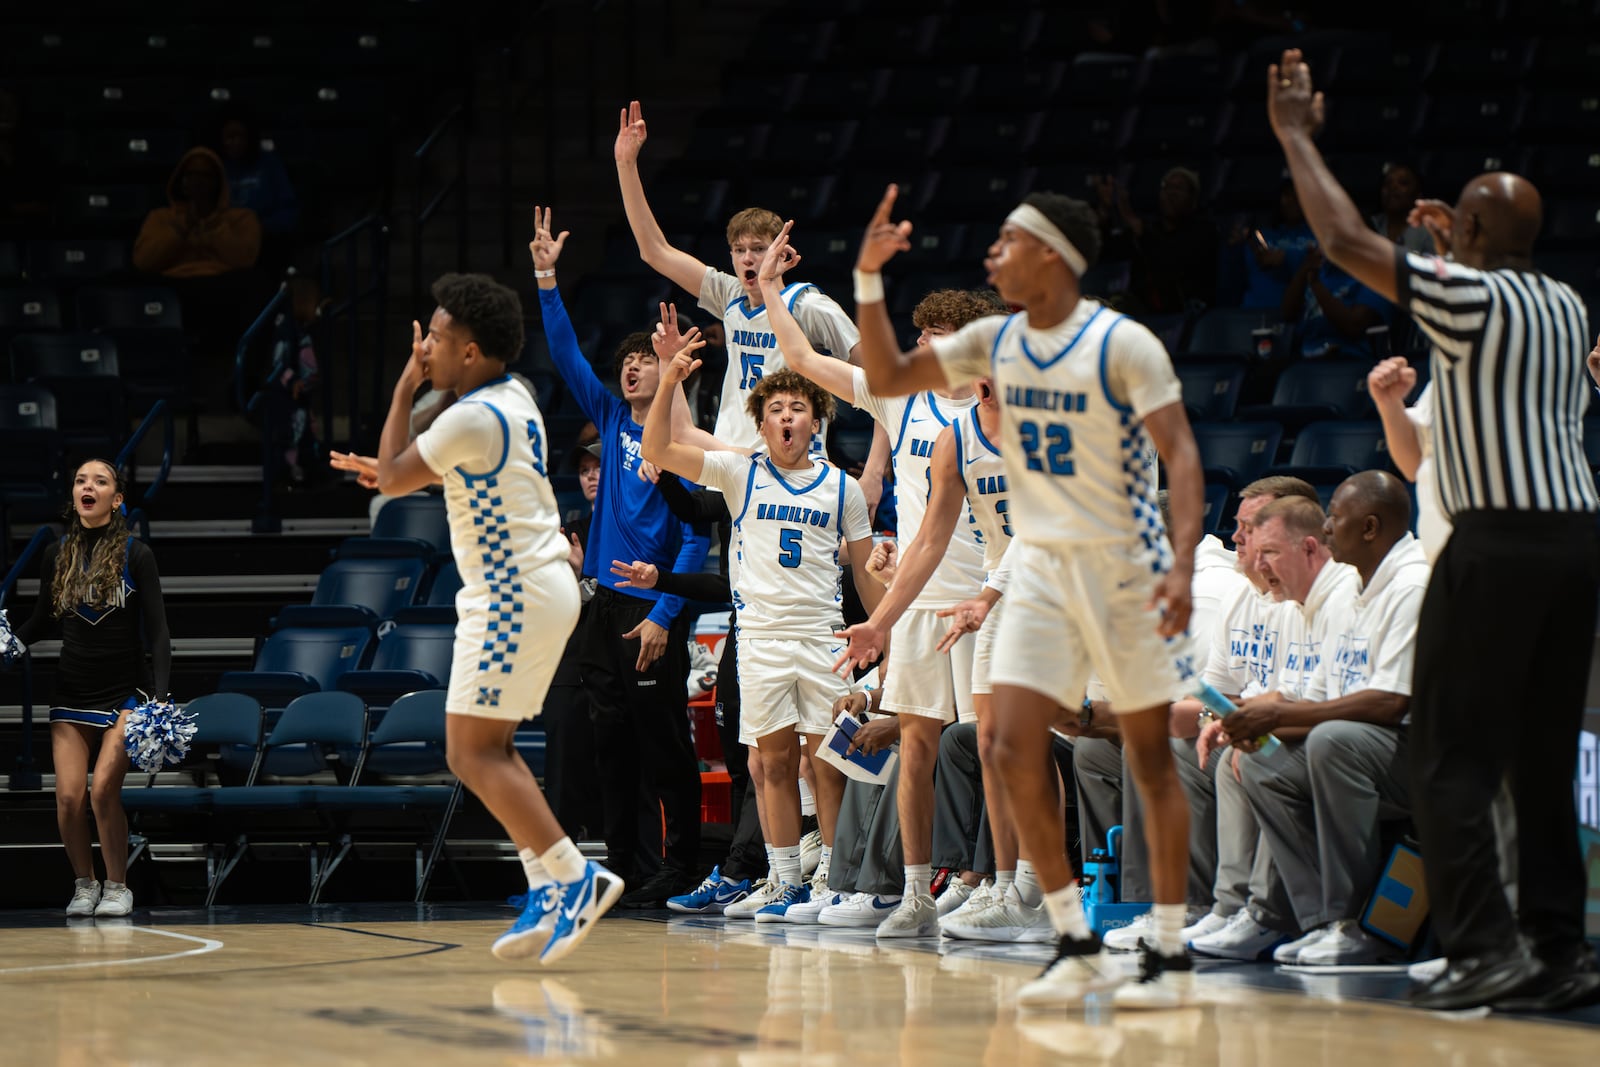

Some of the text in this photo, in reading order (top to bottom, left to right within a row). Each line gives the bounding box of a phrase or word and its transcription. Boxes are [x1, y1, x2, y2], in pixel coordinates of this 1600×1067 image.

[739, 351, 765, 391] 15
[1019, 420, 1076, 476] 22
[756, 503, 831, 529] HAMILTON
[778, 527, 803, 569] 5
